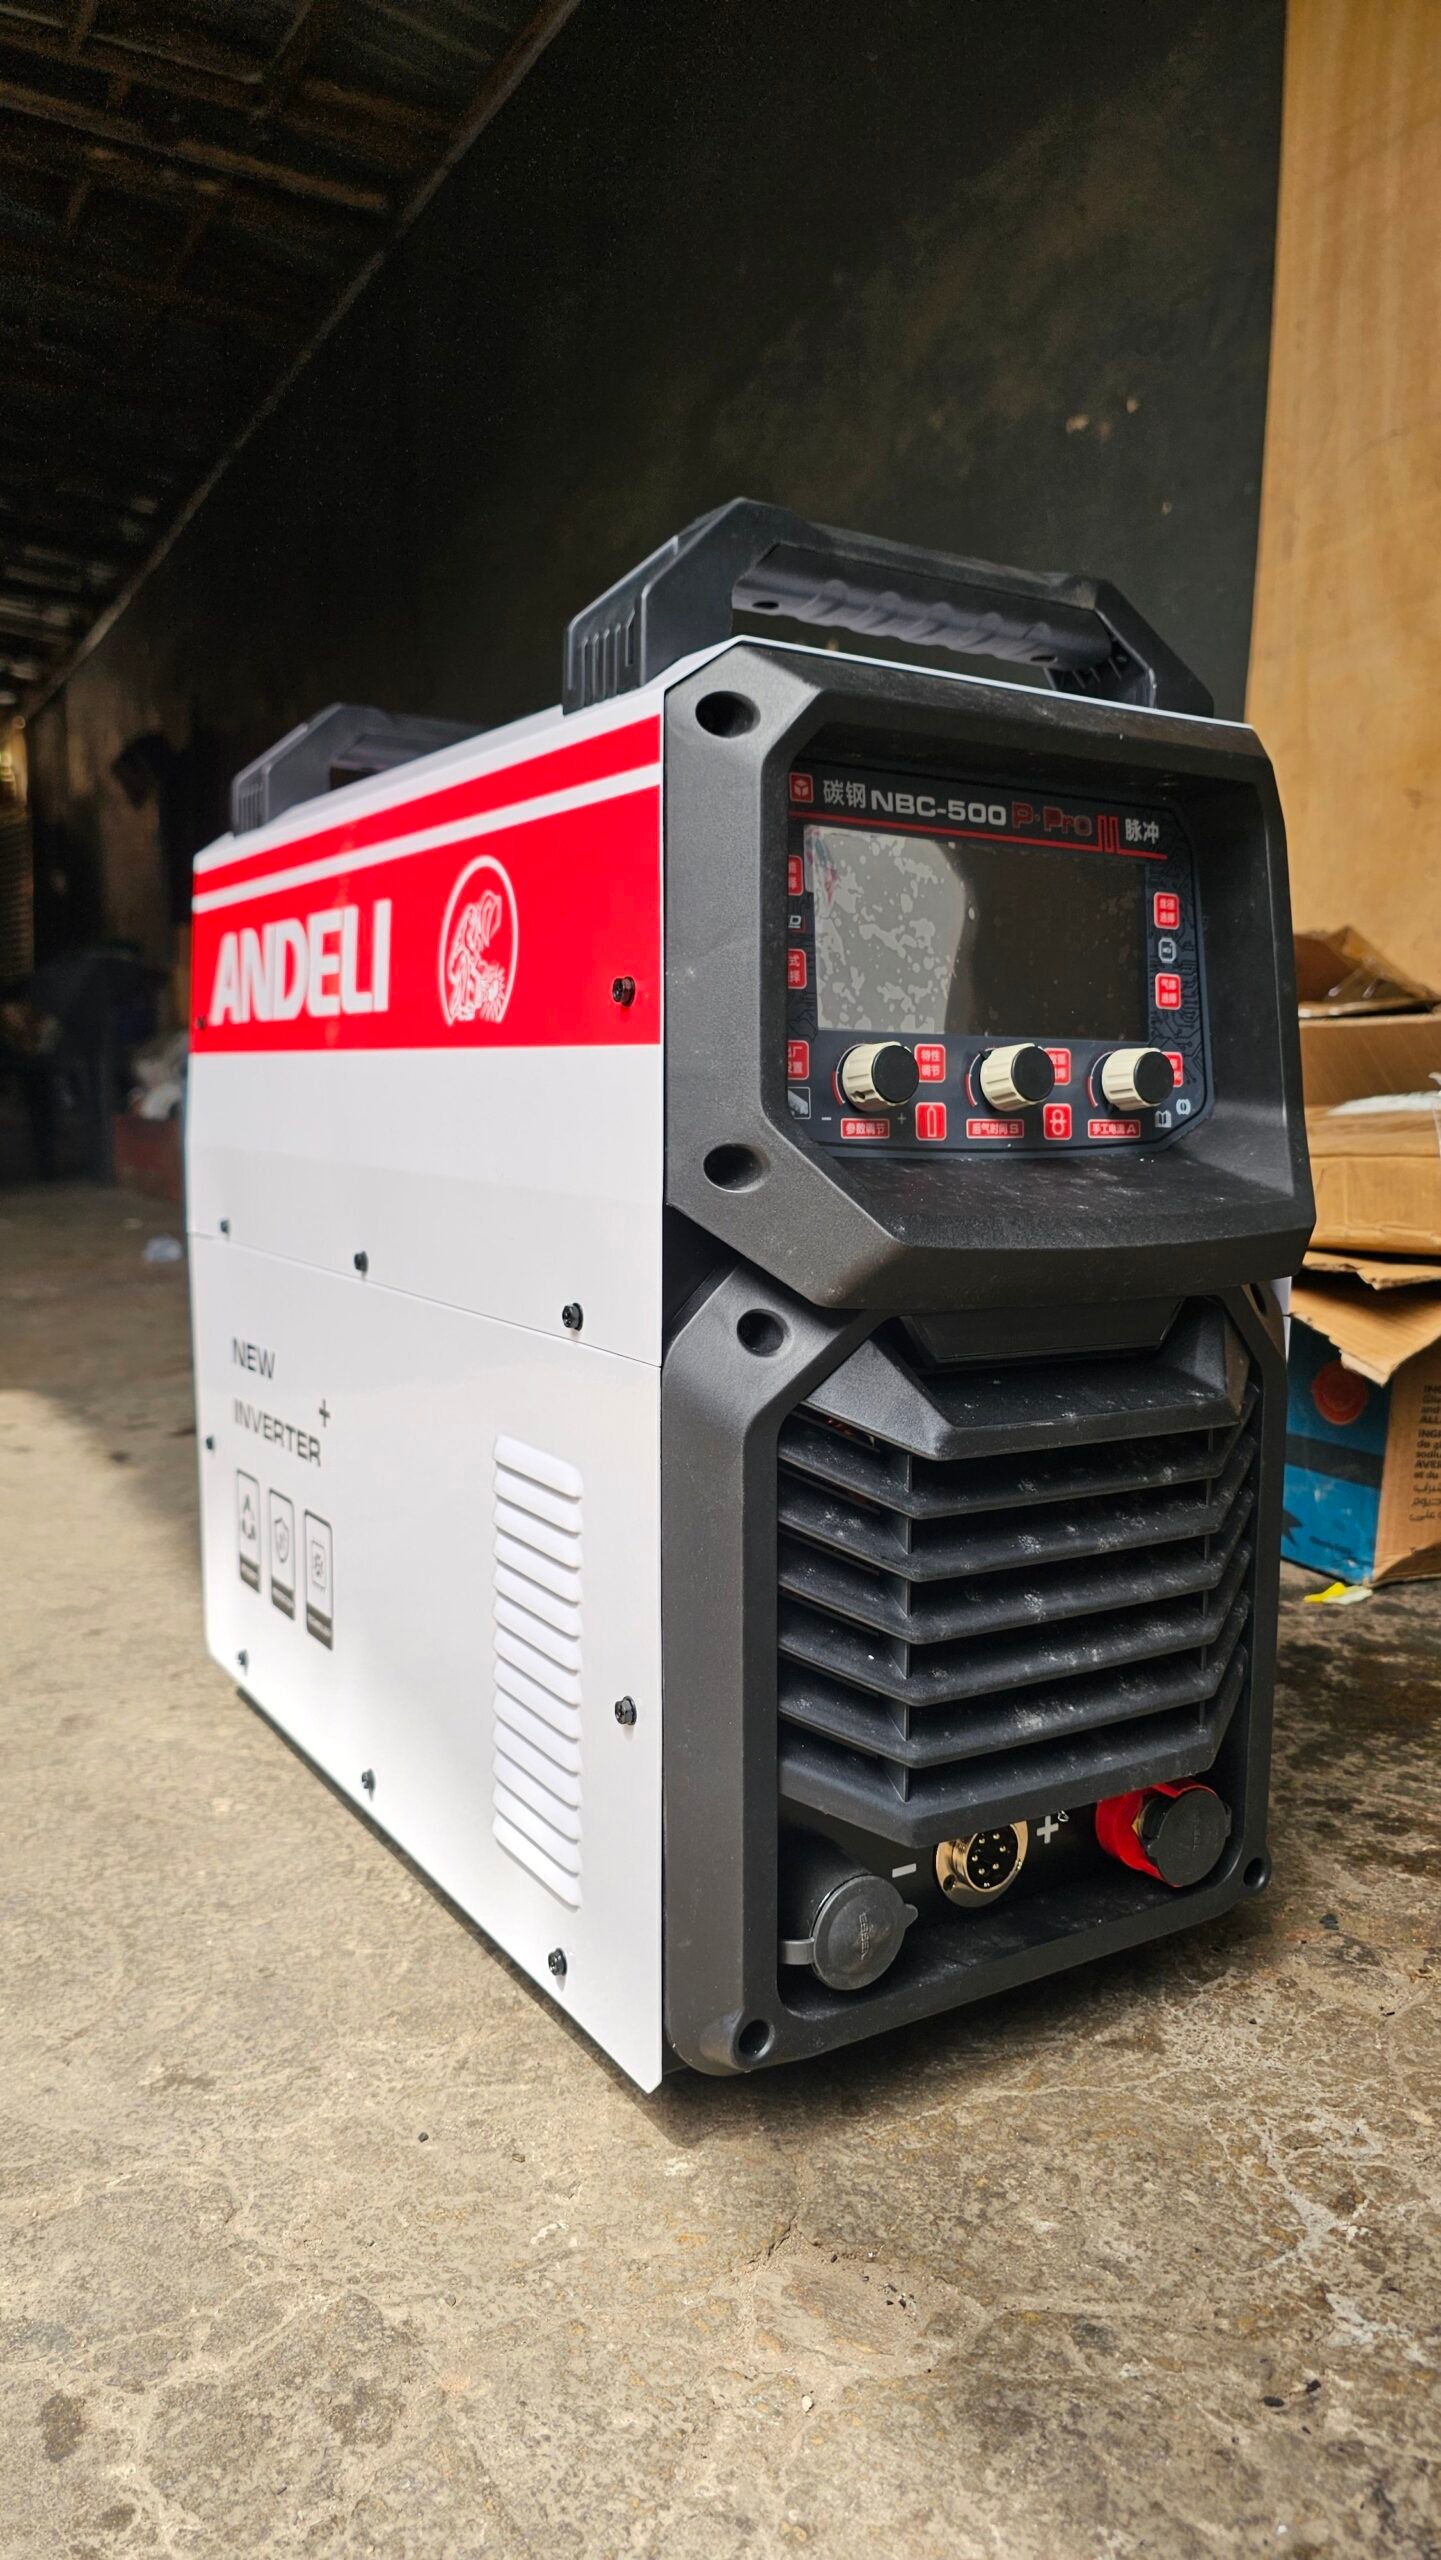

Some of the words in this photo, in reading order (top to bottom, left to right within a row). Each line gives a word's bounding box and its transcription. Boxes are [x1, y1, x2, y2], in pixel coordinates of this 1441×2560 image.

[823, 779, 866, 809] 碳钢
[870, 790, 1007, 826] NBC-500
[1125, 818, 1160, 844] 脉冲
[208, 898, 392, 1027] ANDELI
[232, 1338, 276, 1380] NEW
[234, 1398, 321, 1467] INVERTER
